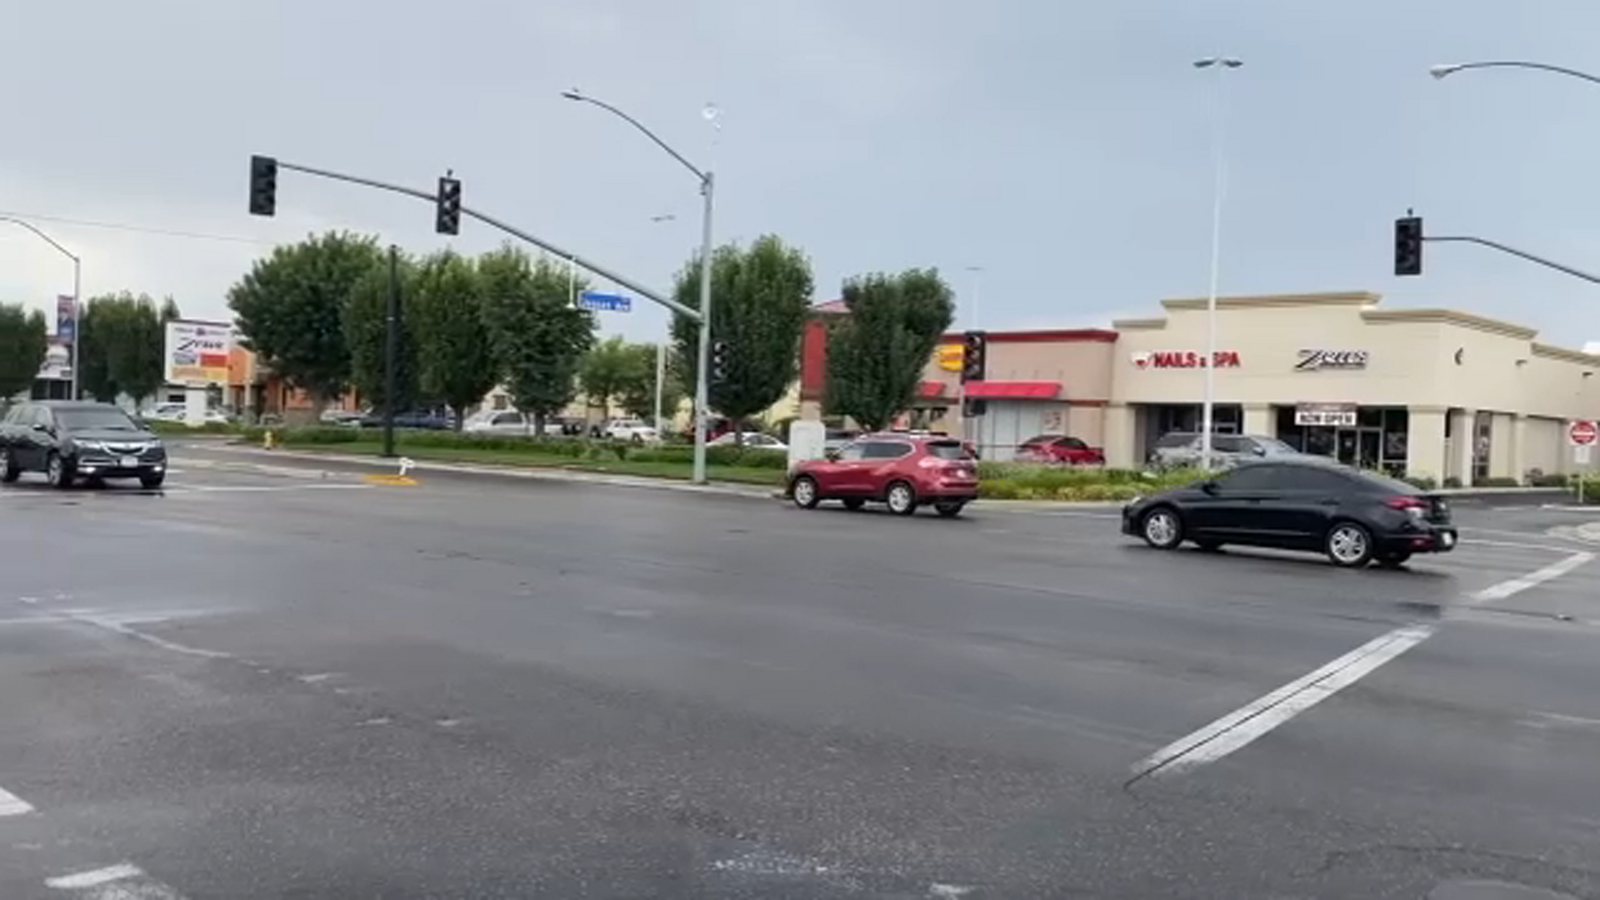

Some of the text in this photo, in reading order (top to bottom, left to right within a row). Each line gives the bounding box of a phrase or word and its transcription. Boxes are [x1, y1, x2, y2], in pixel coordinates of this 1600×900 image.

[1153, 351, 1196, 368] NAILS
[1212, 351, 1241, 368] SPA
[1323, 414, 1353, 423] OPEN
